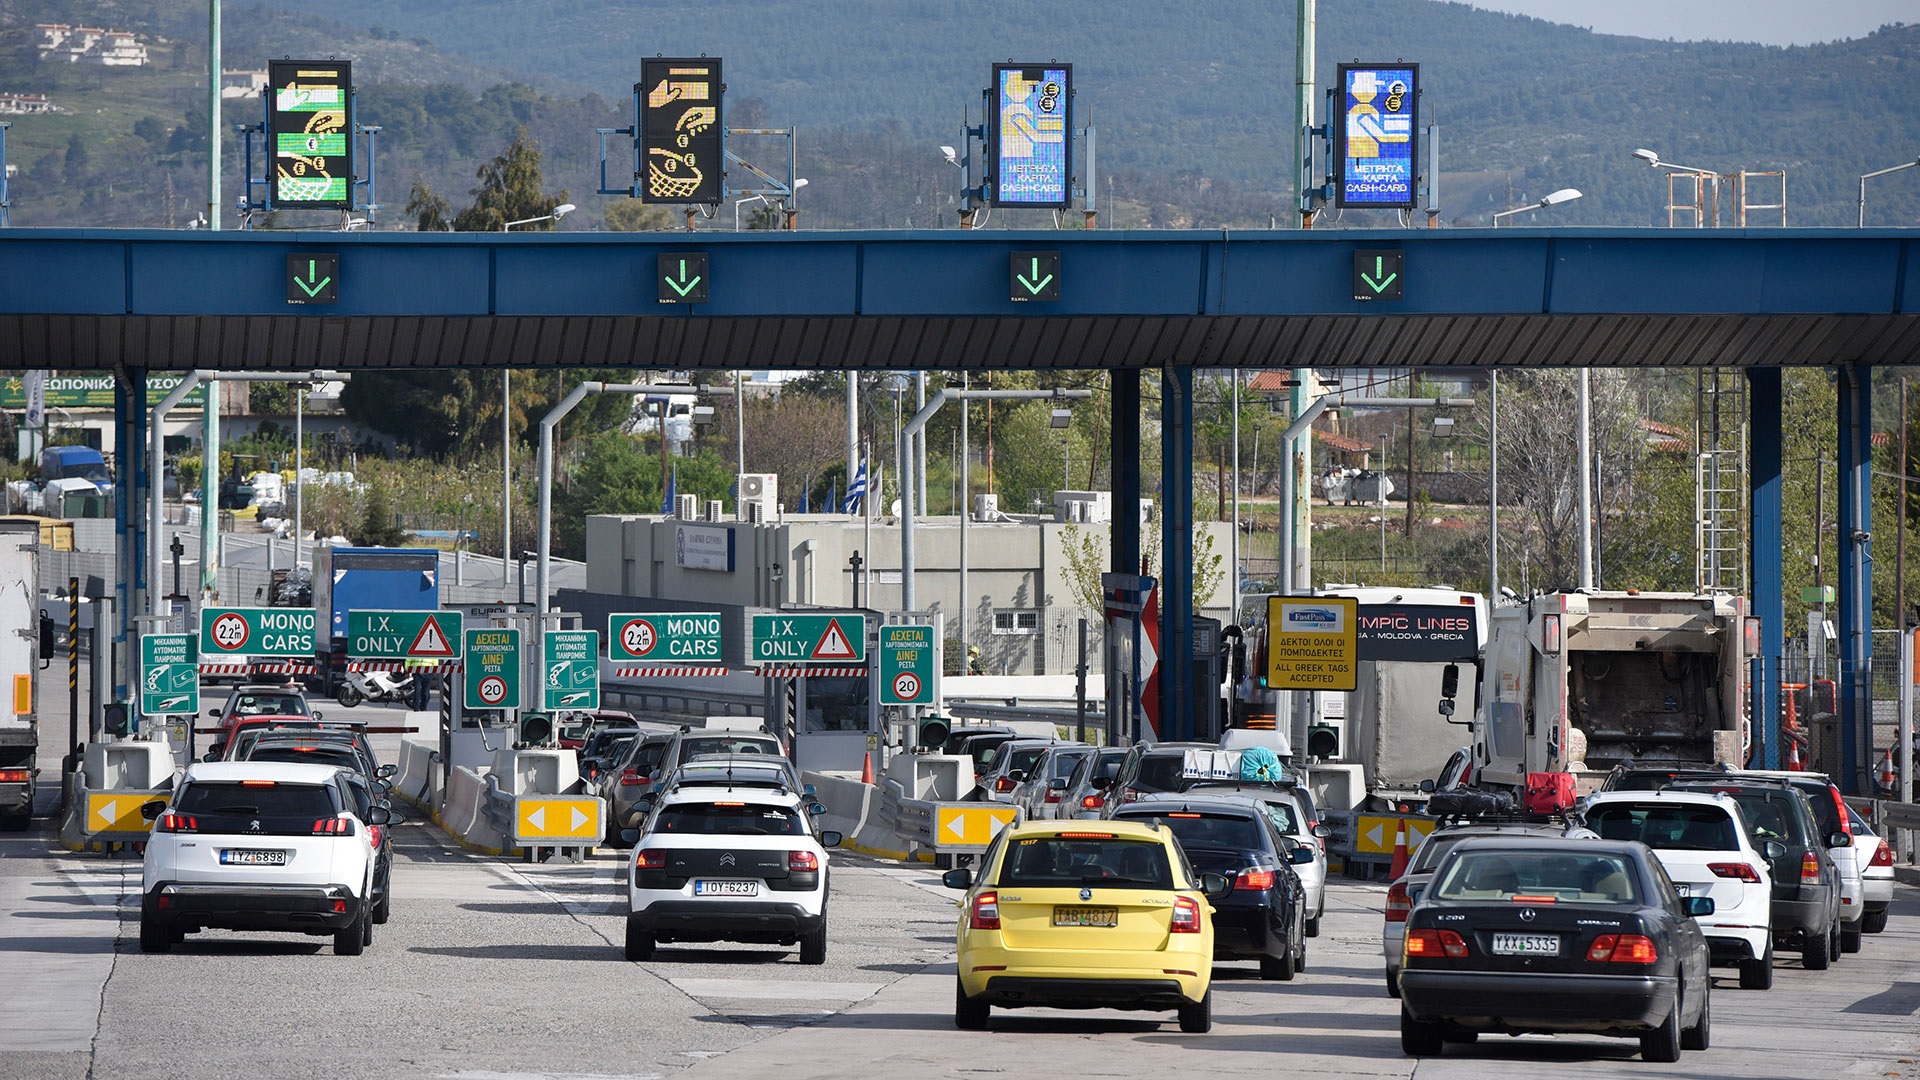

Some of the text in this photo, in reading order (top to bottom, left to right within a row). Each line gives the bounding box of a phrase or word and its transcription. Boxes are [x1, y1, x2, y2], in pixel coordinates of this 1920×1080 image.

[1358, 616, 1470, 631] MPIC LINES
[475, 633, 510, 645] ΔΕΧΕΤΑΙ
[890, 630, 924, 641] ΔΕΧΕΤΑΙ
[1377, 632, 1423, 640] MOLDOVA
[1430, 633, 1464, 641] GRECIA
[262, 634, 312, 651] CARS
[356, 636, 405, 653] ONLY
[555, 643, 587, 651] ΑΥΤΟΜΑΤΗΣ
[669, 640, 718, 655] CARS
[1280, 638, 1345, 646] ΔΕΚΤΟΙ ΟΛΟΙ ΟΙ
[154, 646, 187, 654] ΑΥΤΟΜΑΤΗΣ
[761, 640, 808, 656] ONLY
[1280, 648, 1344, 657] ΠΟΜΠΟΔΕΚΤΕΣ
[481, 653, 504, 665] ΔΙΝΕΙ
[896, 650, 918, 661] ΔΙΝΕΙ
[484, 665, 501, 673] ΡΕΣΤΑ
[898, 661, 915, 669] ΡΕΣΤΑ
[1275, 663, 1349, 672] ALL GREEK TAGS
[1290, 674, 1334, 683] ACCEPTED
[484, 684, 501, 696] 20
[898, 680, 915, 692] 20
